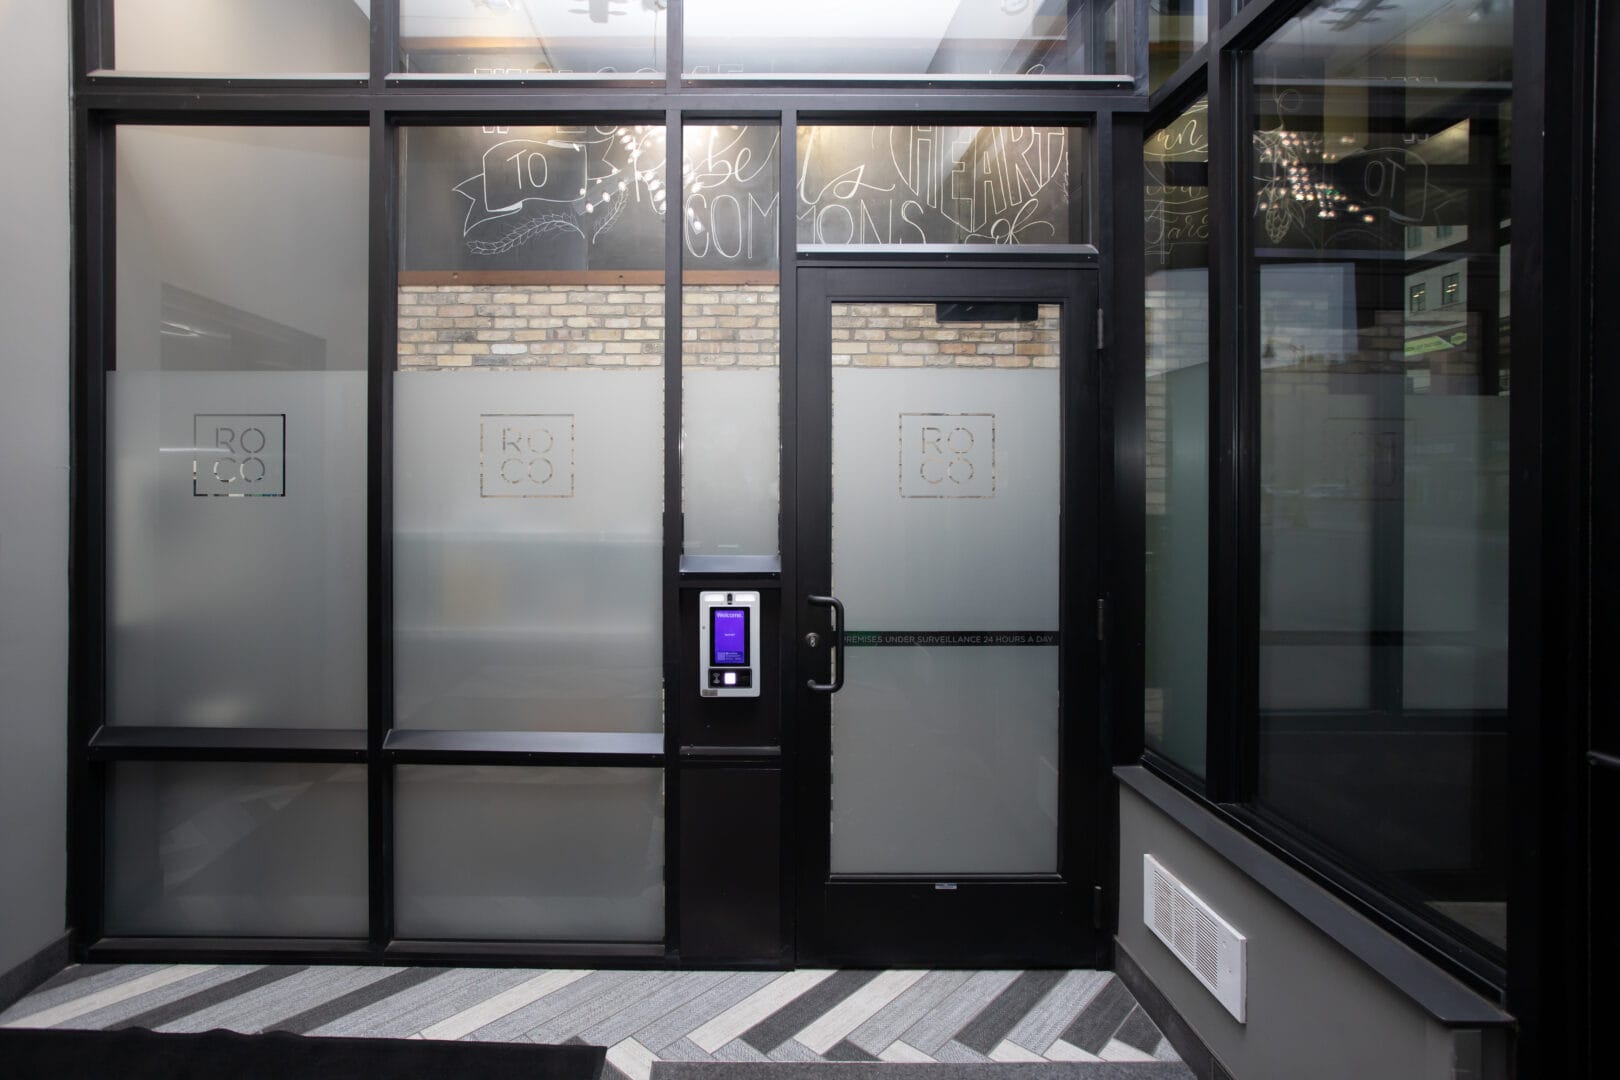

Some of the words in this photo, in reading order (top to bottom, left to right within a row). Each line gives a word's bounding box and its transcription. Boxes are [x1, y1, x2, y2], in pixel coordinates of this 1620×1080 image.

[506, 149, 549, 191] TO
[885, 635, 915, 644] UNDER
[917, 635, 982, 644] SURVEILLANCE
[983, 635, 994, 644] 24
[996, 635, 1026, 644] HOURS
[1027, 635, 1035, 644] A
[1036, 635, 1054, 644] DAY
